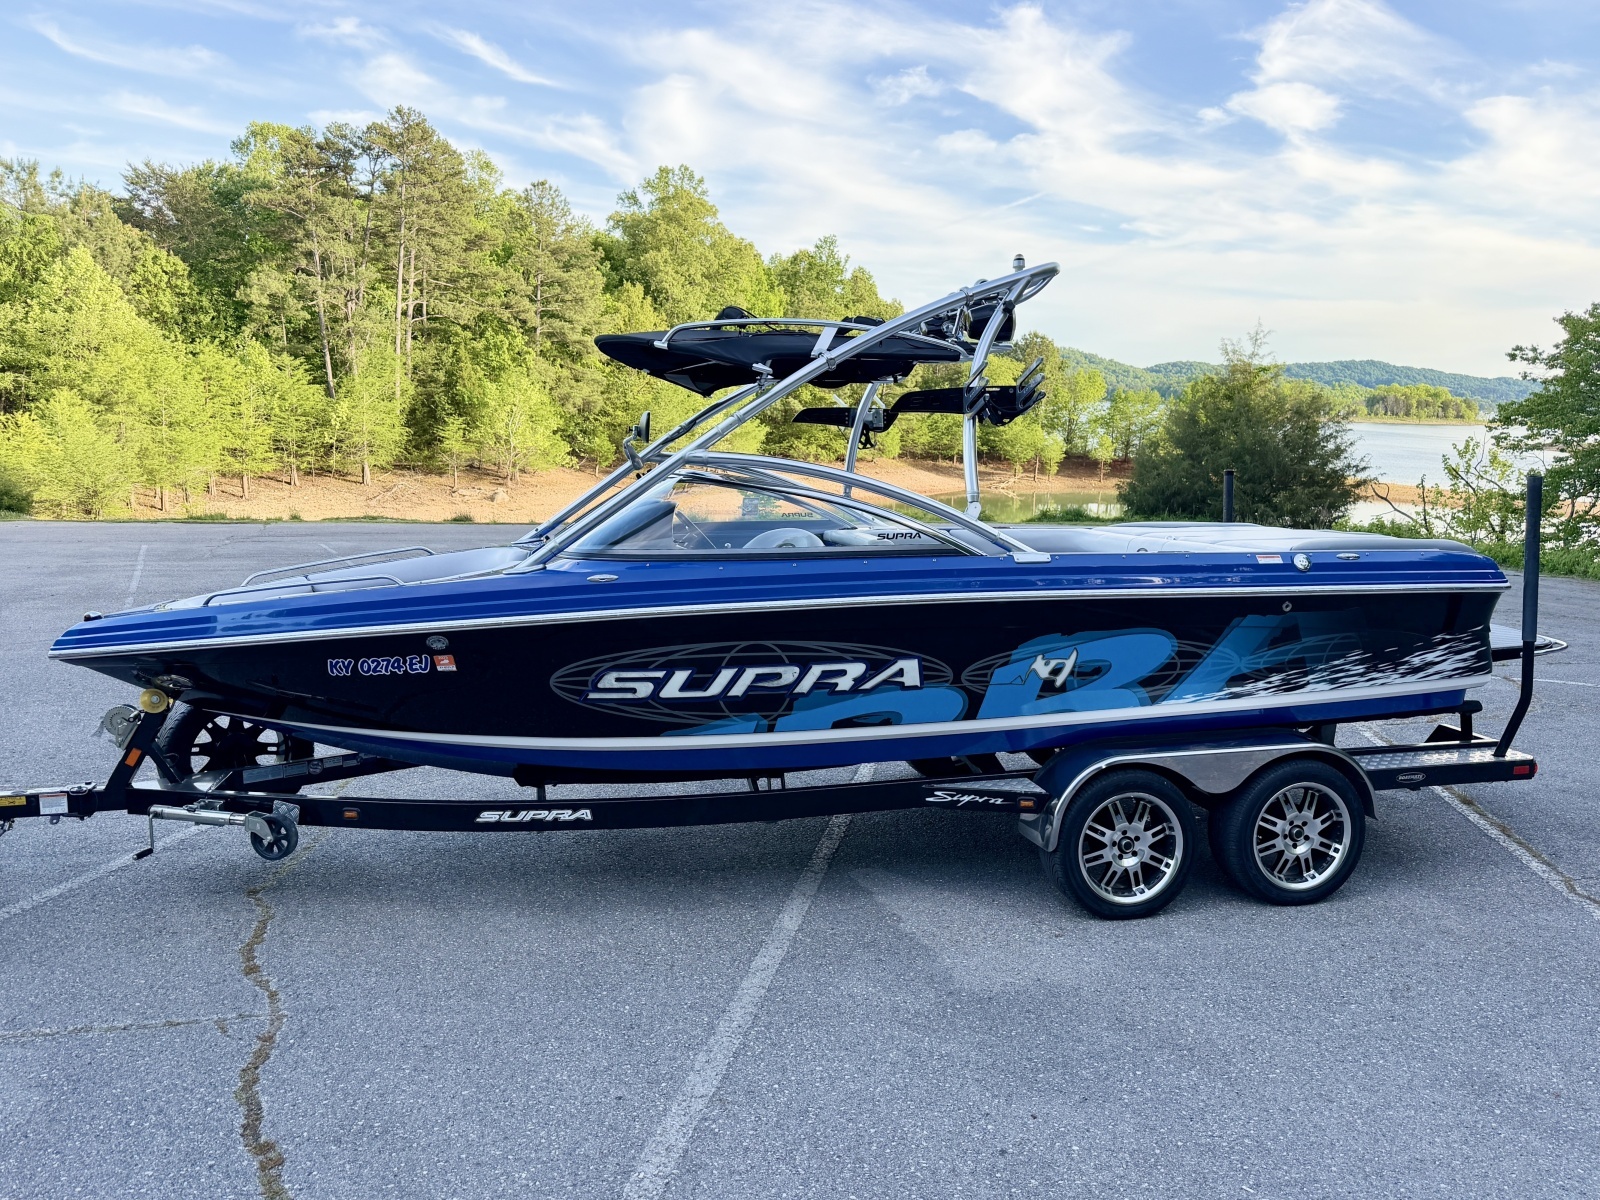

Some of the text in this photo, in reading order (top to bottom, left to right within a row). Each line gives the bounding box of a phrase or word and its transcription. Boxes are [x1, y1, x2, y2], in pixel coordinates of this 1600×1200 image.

[877, 532, 922, 541] SUPRA
[327, 654, 431, 676] KY 0274 EJ
[583, 656, 923, 701] SUPRA
[925, 789, 1008, 805] Supra
[475, 808, 593, 823] SUPRA
